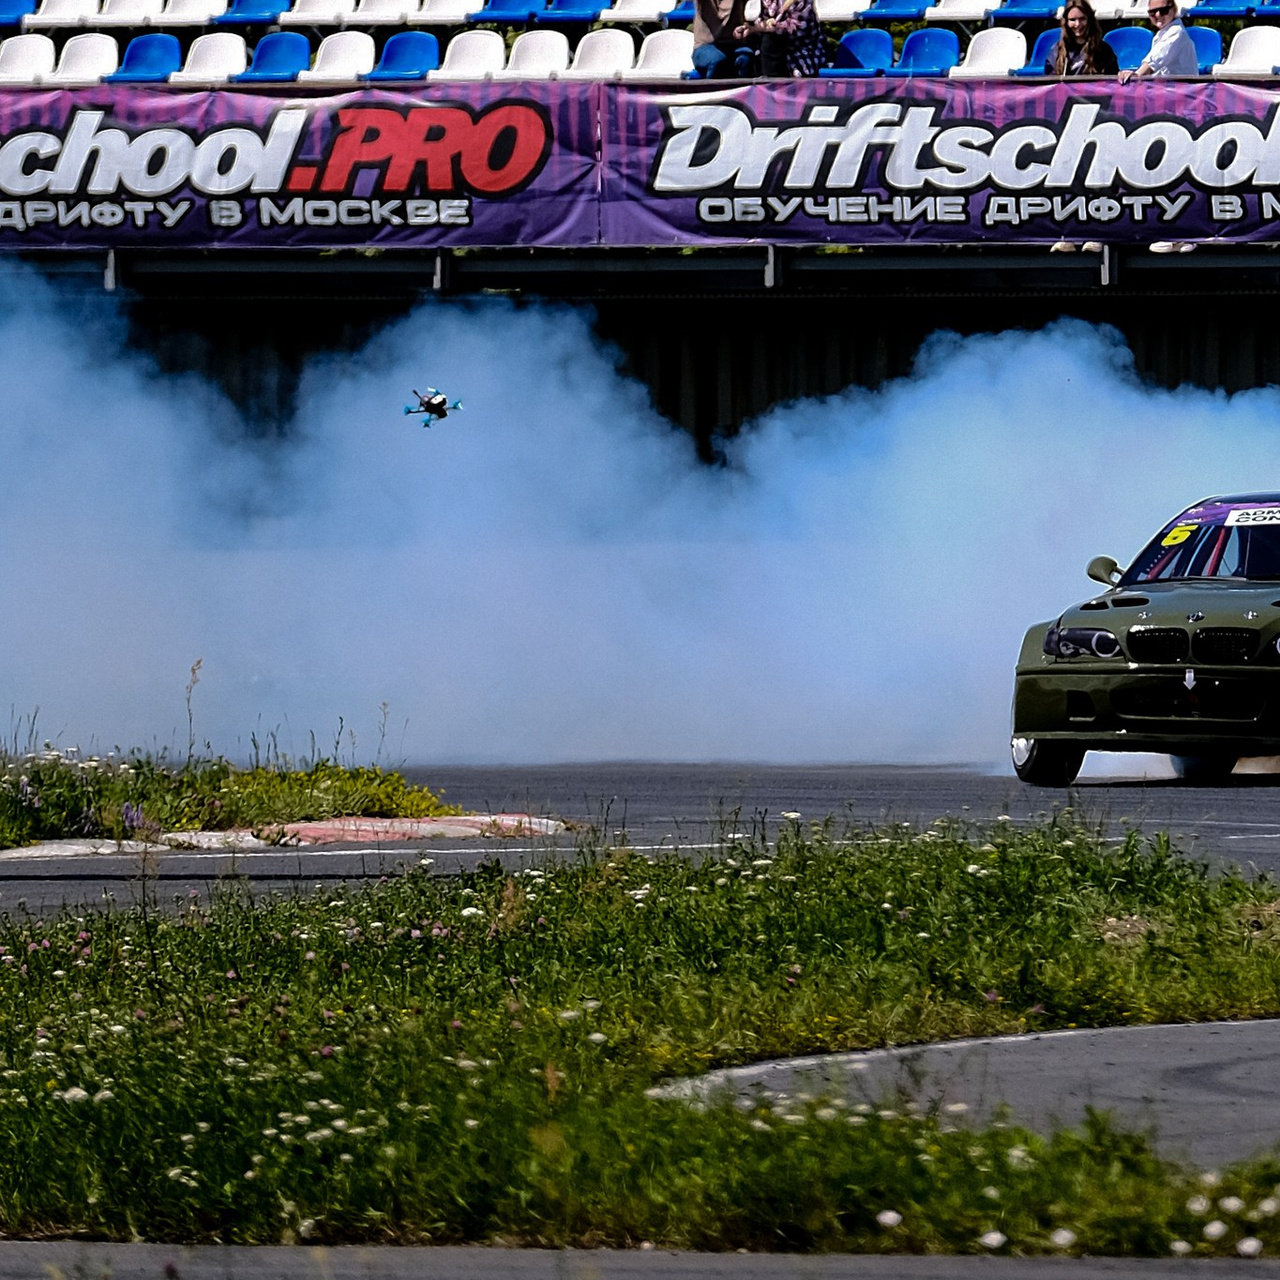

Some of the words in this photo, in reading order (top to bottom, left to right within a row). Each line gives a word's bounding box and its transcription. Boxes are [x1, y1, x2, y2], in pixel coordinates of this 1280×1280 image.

[212, 200, 242, 225] В
[700, 197, 965, 222] ОБУЧЕНИЕ
[986, 196, 1190, 224] ДРИФТУ
[1212, 196, 1243, 220] В
